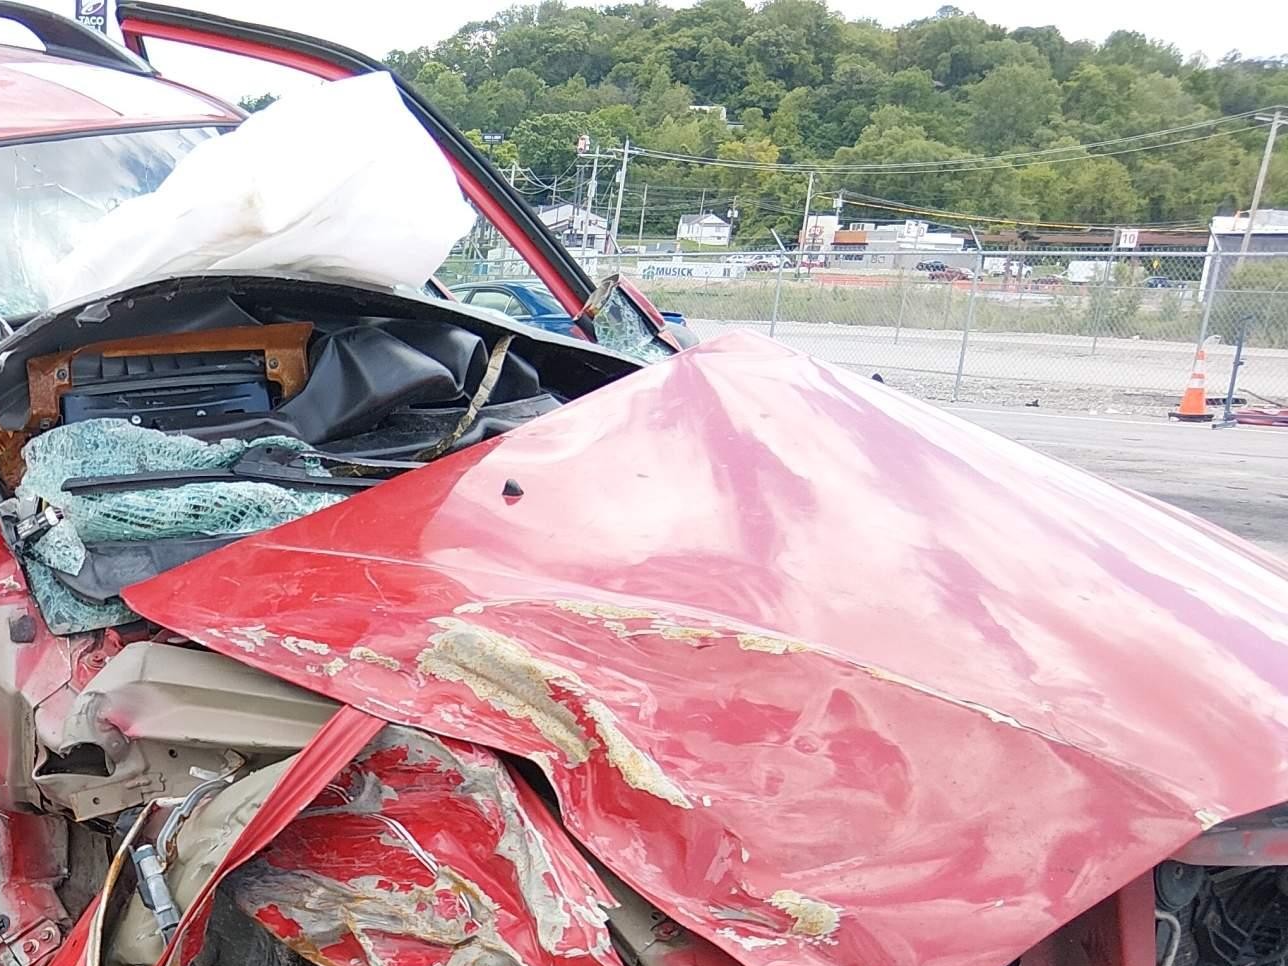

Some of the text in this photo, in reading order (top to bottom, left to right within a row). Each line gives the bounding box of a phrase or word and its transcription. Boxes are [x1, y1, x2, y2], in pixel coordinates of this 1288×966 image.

[79, 16, 103, 25] TACO
[1123, 234, 1135, 244] 10
[655, 267, 694, 277] MUSICK
